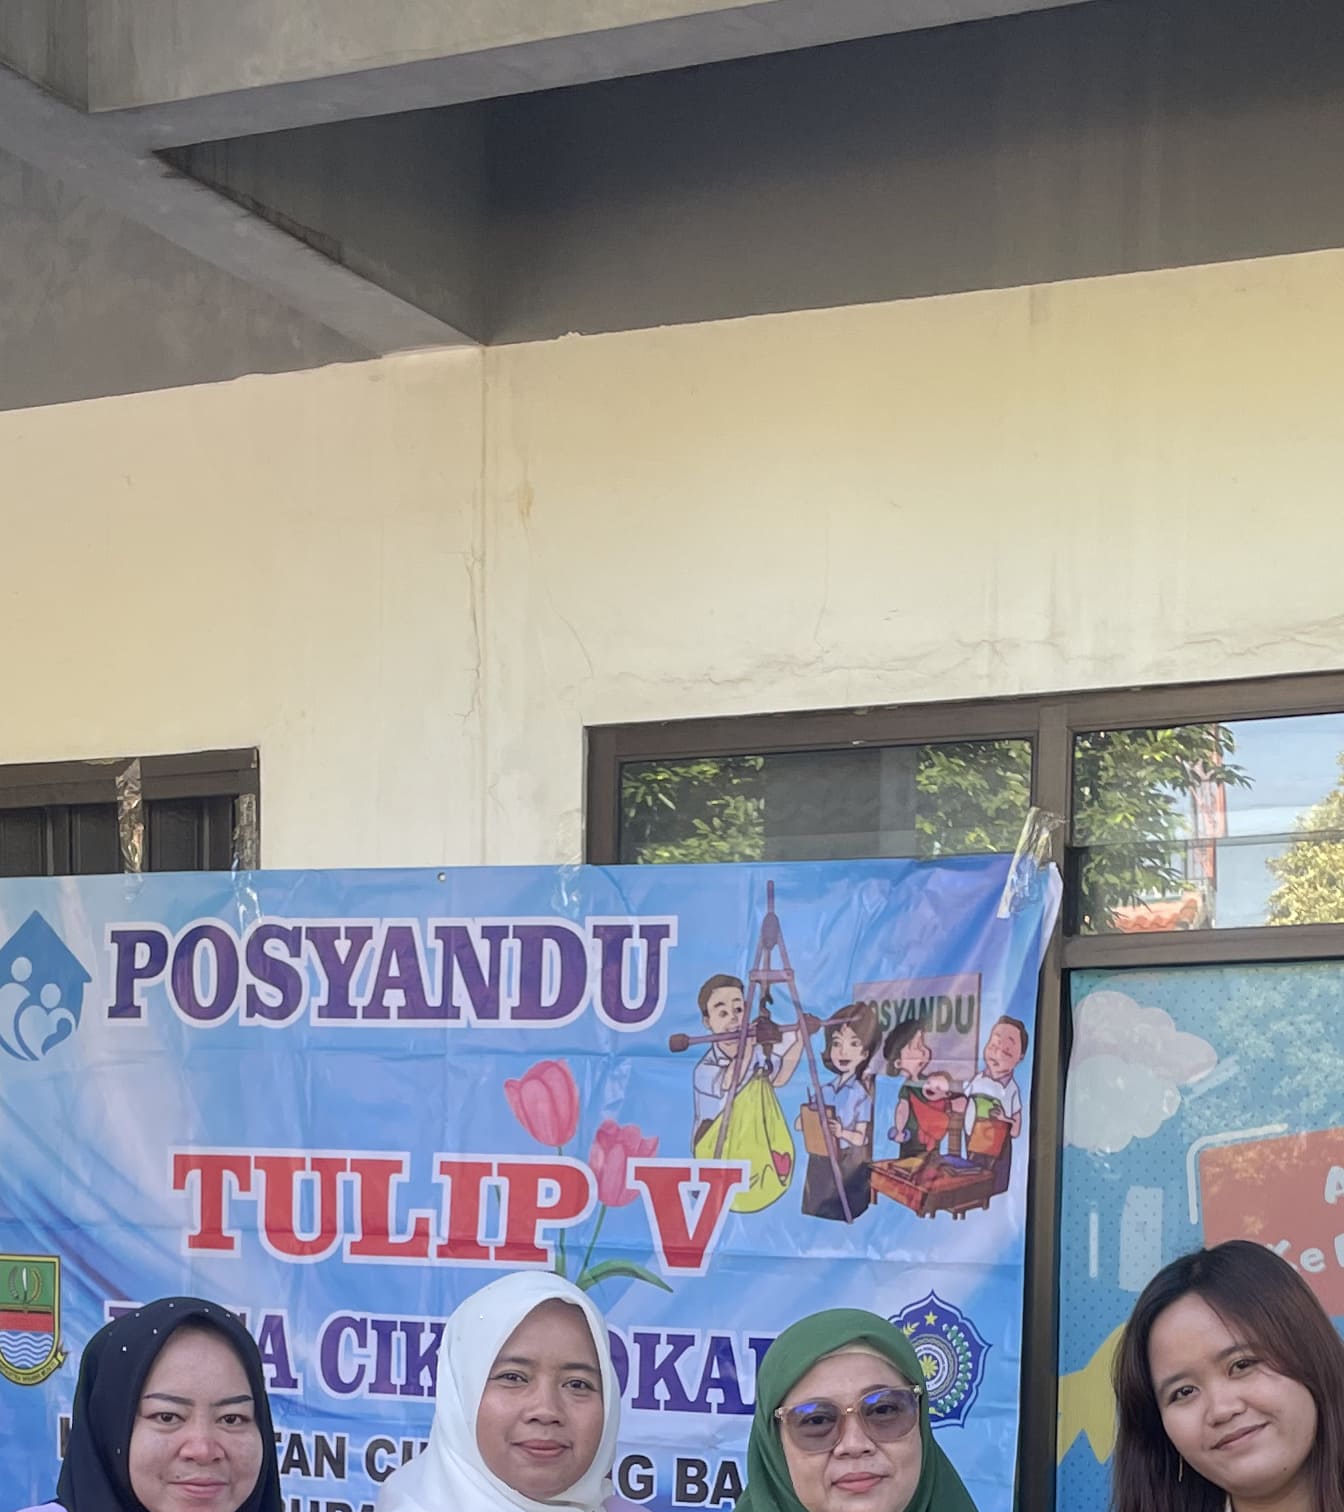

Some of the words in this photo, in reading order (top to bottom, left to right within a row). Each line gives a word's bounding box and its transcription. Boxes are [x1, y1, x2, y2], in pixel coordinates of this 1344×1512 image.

[105, 922, 672, 1026] POSYANDU
[172, 1153, 591, 1264] TULIP
[634, 1166, 744, 1269] V
